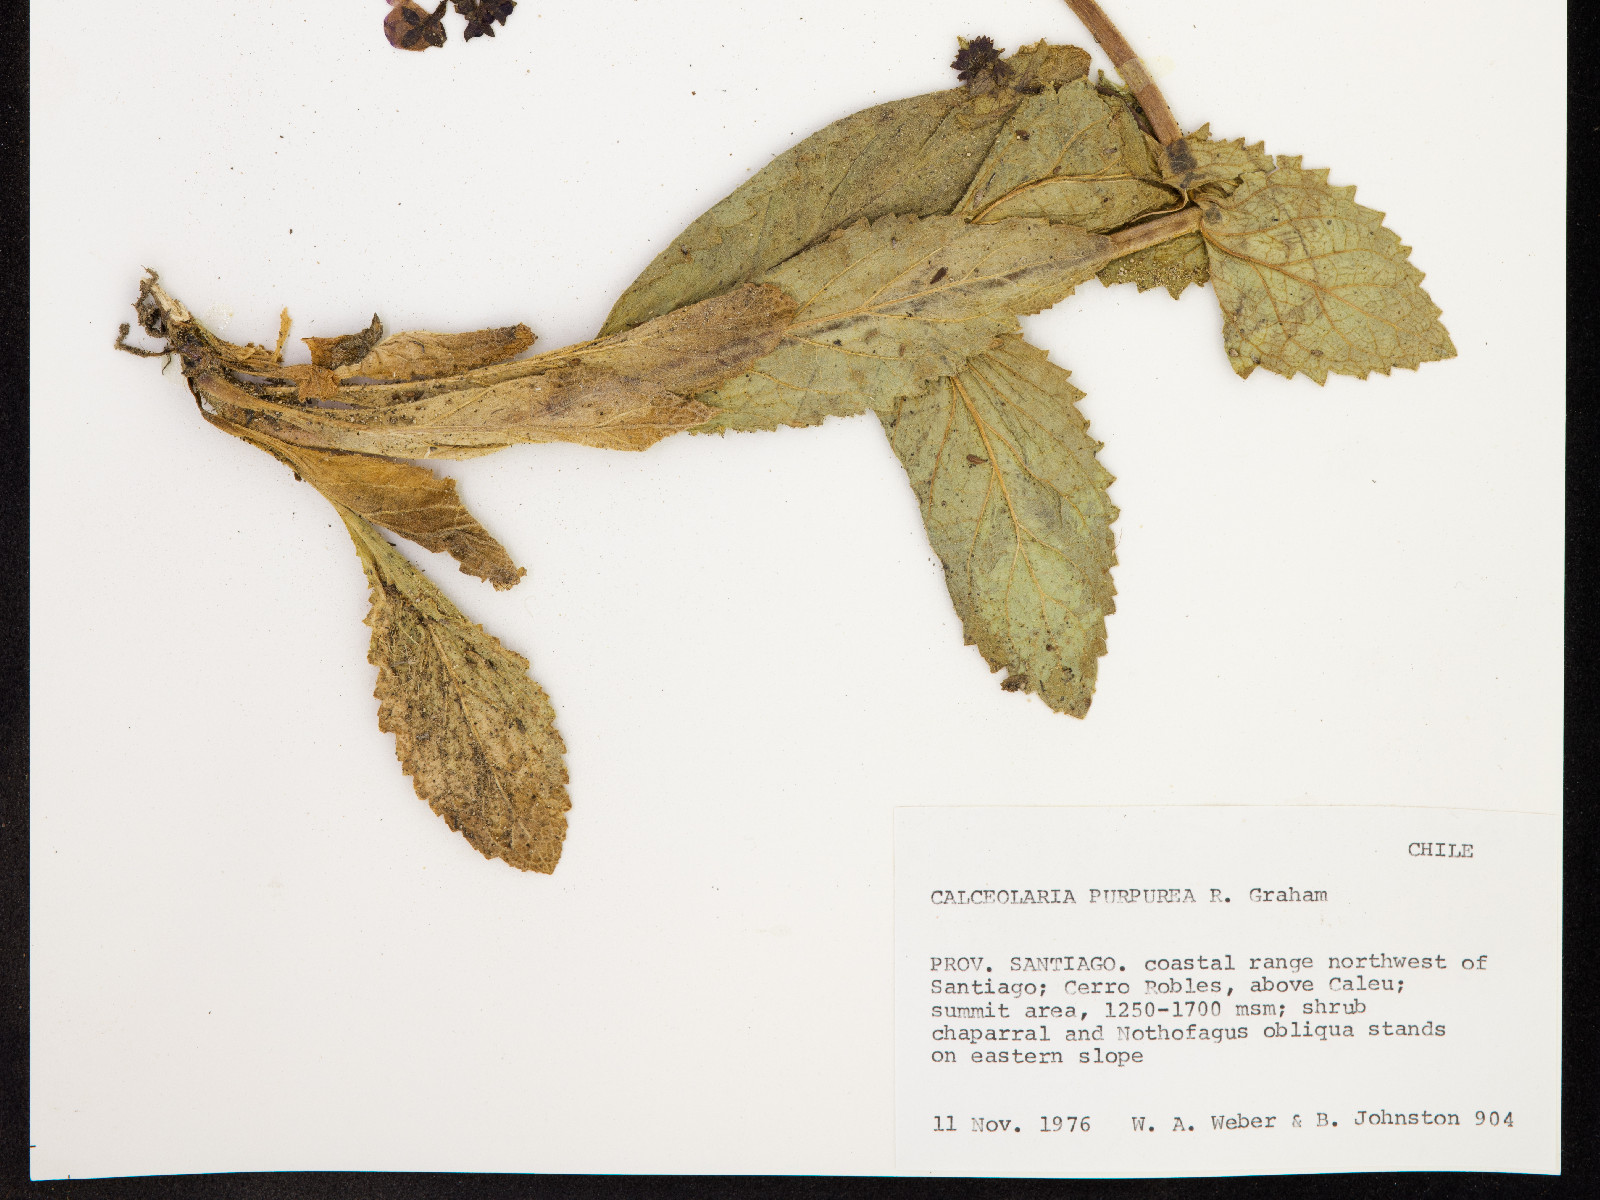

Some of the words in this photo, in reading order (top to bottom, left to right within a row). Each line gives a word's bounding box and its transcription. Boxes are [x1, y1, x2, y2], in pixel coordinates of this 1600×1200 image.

[1408, 842, 1474, 858] CHILE
[930, 889, 1077, 905] CALCEOLARIA
[1089, 888, 1196, 904] PURPUREA
[1209, 888, 1231, 903] R.
[1249, 886, 1328, 902] Graham
[930, 956, 993, 973] PROV.
[1010, 956, 1126, 972] SANTIAGO.
[1144, 954, 1236, 971] coastal
[1249, 957, 1314, 973] range
[1328, 953, 1447, 969] northwest
[1461, 954, 1488, 970] of
[931, 978, 1047, 998] Santiago;
[1064, 980, 1130, 995] Cerro
[1144, 977, 1234, 997] Robles,
[1250, 976, 1314, 993] above
[1329, 974, 1404, 994] Caleu;
[931, 1003, 1010, 1019] summit
[1025, 1005, 1088, 1022] area,
[1105, 1001, 1222, 1018] 1250-1700
[1235, 1003, 1286, 1018] msm;
[1302, 998, 1367, 1015] shrub
[931, 1024, 1051, 1045] chaparral
[1065, 1025, 1104, 1042] and
[1117, 1023, 1248, 1044] Nothofagus
[1263, 1021, 1355, 1041] obliqua
[1368, 1020, 1446, 1037] stands
[931, 1050, 957, 1064] on
[971, 1048, 1064, 1064] eastern
[1079, 1047, 1144, 1068] slope
[934, 1115, 957, 1132] 11
[971, 1117, 1021, 1133] Nov.
[1040, 1115, 1091, 1133] 1976
[1131, 1116, 1155, 1132] W.
[1172, 1116, 1195, 1132] A.
[1210, 1113, 1277, 1130] Weber
[1292, 1114, 1302, 1128] &
[1316, 1112, 1338, 1128] B.
[1354, 1109, 1460, 1126] Johnston
[1475, 1111, 1514, 1128] 904
